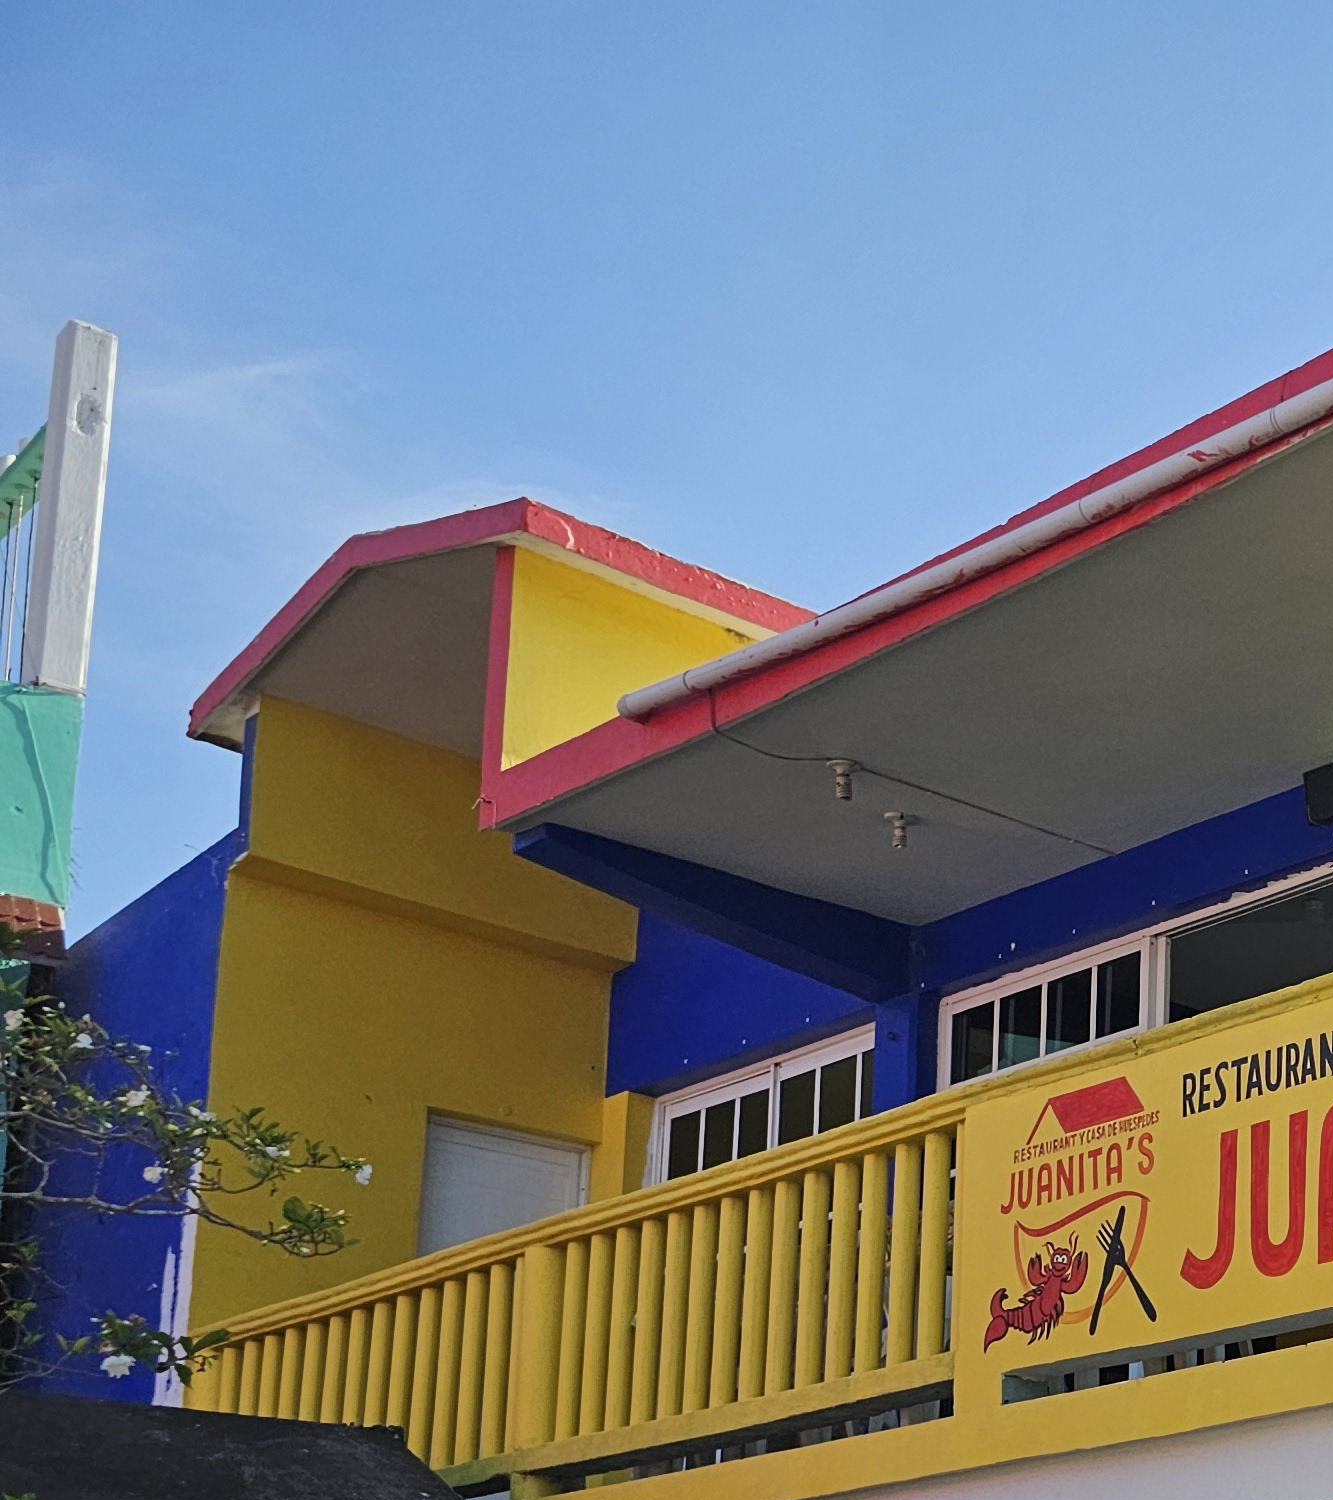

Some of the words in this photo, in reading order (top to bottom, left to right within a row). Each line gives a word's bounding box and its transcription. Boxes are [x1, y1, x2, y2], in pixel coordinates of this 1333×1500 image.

[1013, 1133, 1077, 1164] RESTAURANT
[1079, 1131, 1086, 1145] Y
[1086, 1125, 1107, 1144] CASA
[1107, 1121, 1118, 1137] DE
[1118, 1110, 1160, 1134] HUESPEDES
[1000, 1132, 1155, 1215] JUANITA'S
